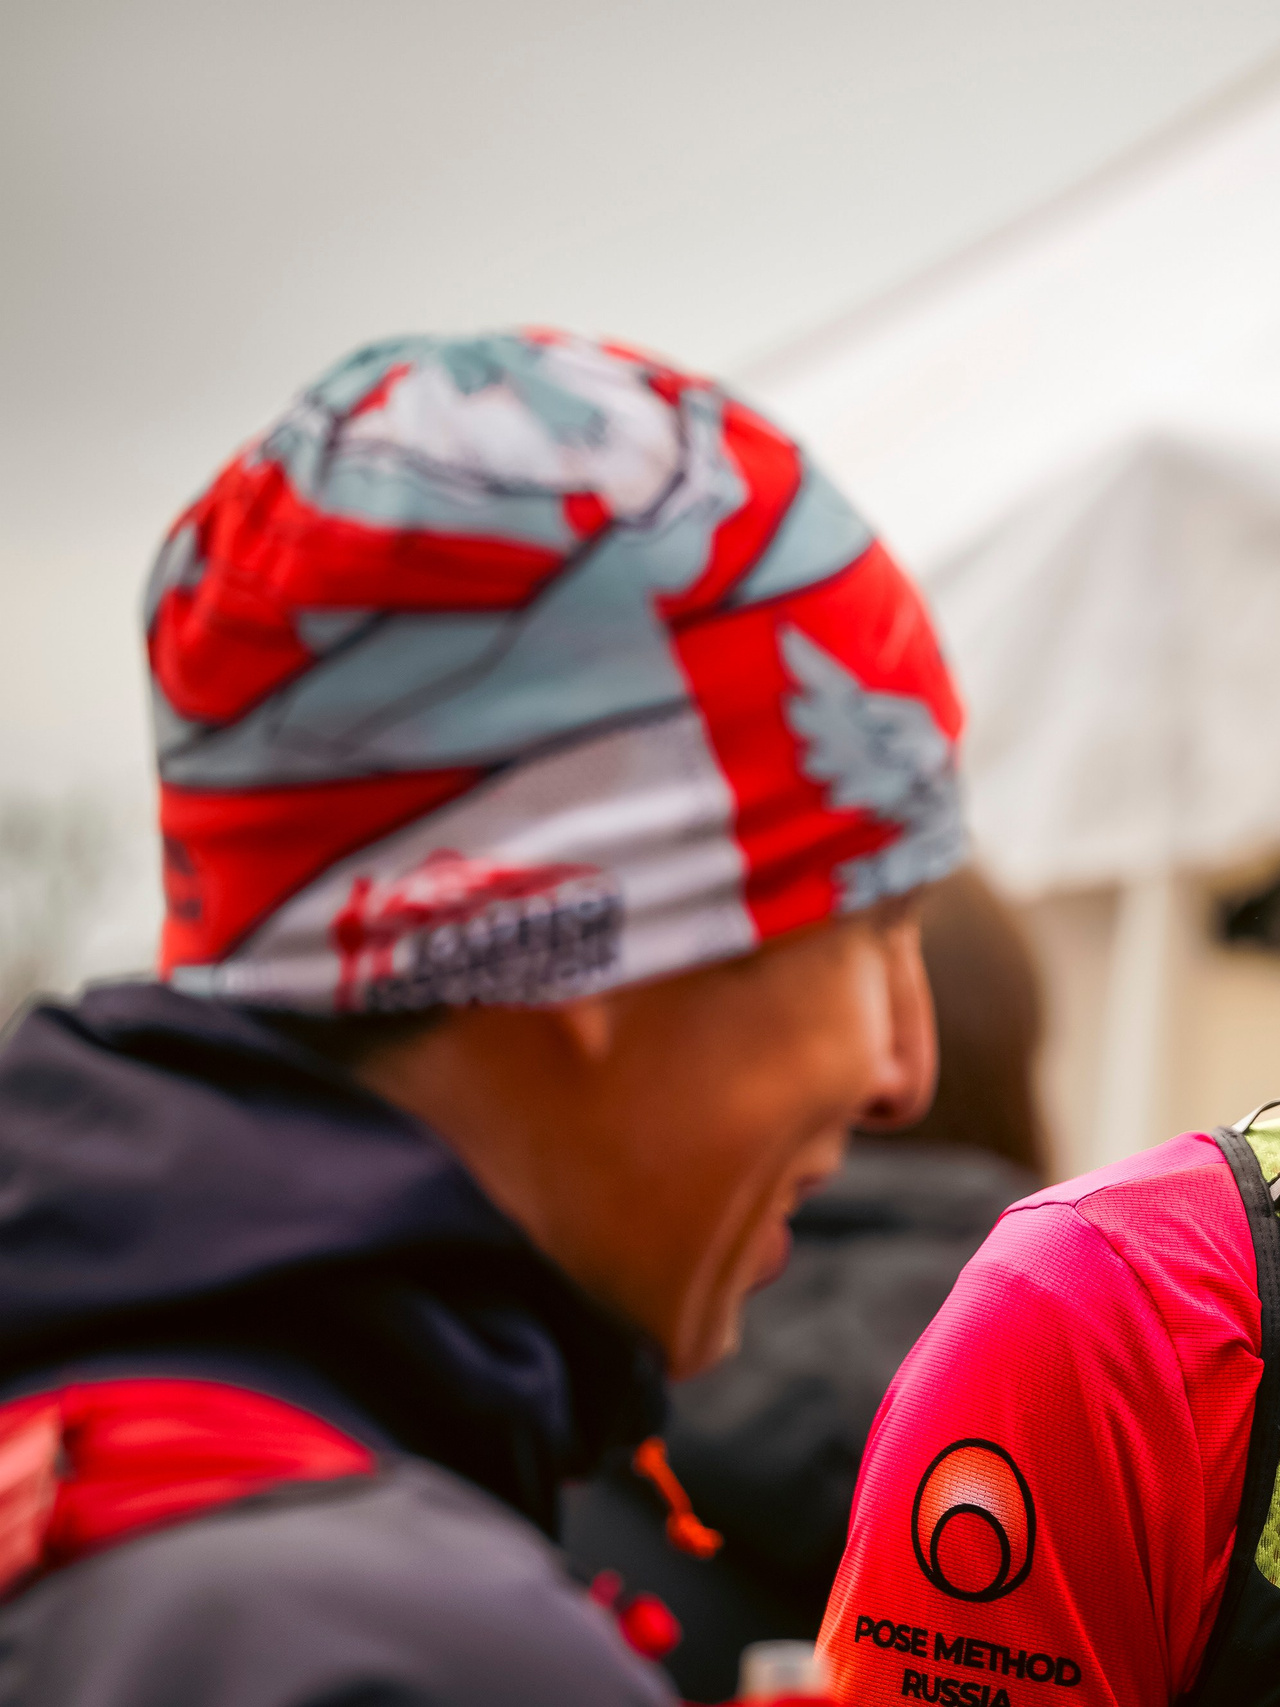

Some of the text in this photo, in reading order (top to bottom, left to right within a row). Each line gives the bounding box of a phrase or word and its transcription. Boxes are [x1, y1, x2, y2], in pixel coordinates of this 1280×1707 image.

[854, 1615, 1082, 1687] POSE METHOD
[901, 1668, 1012, 1707] RUSSIA
